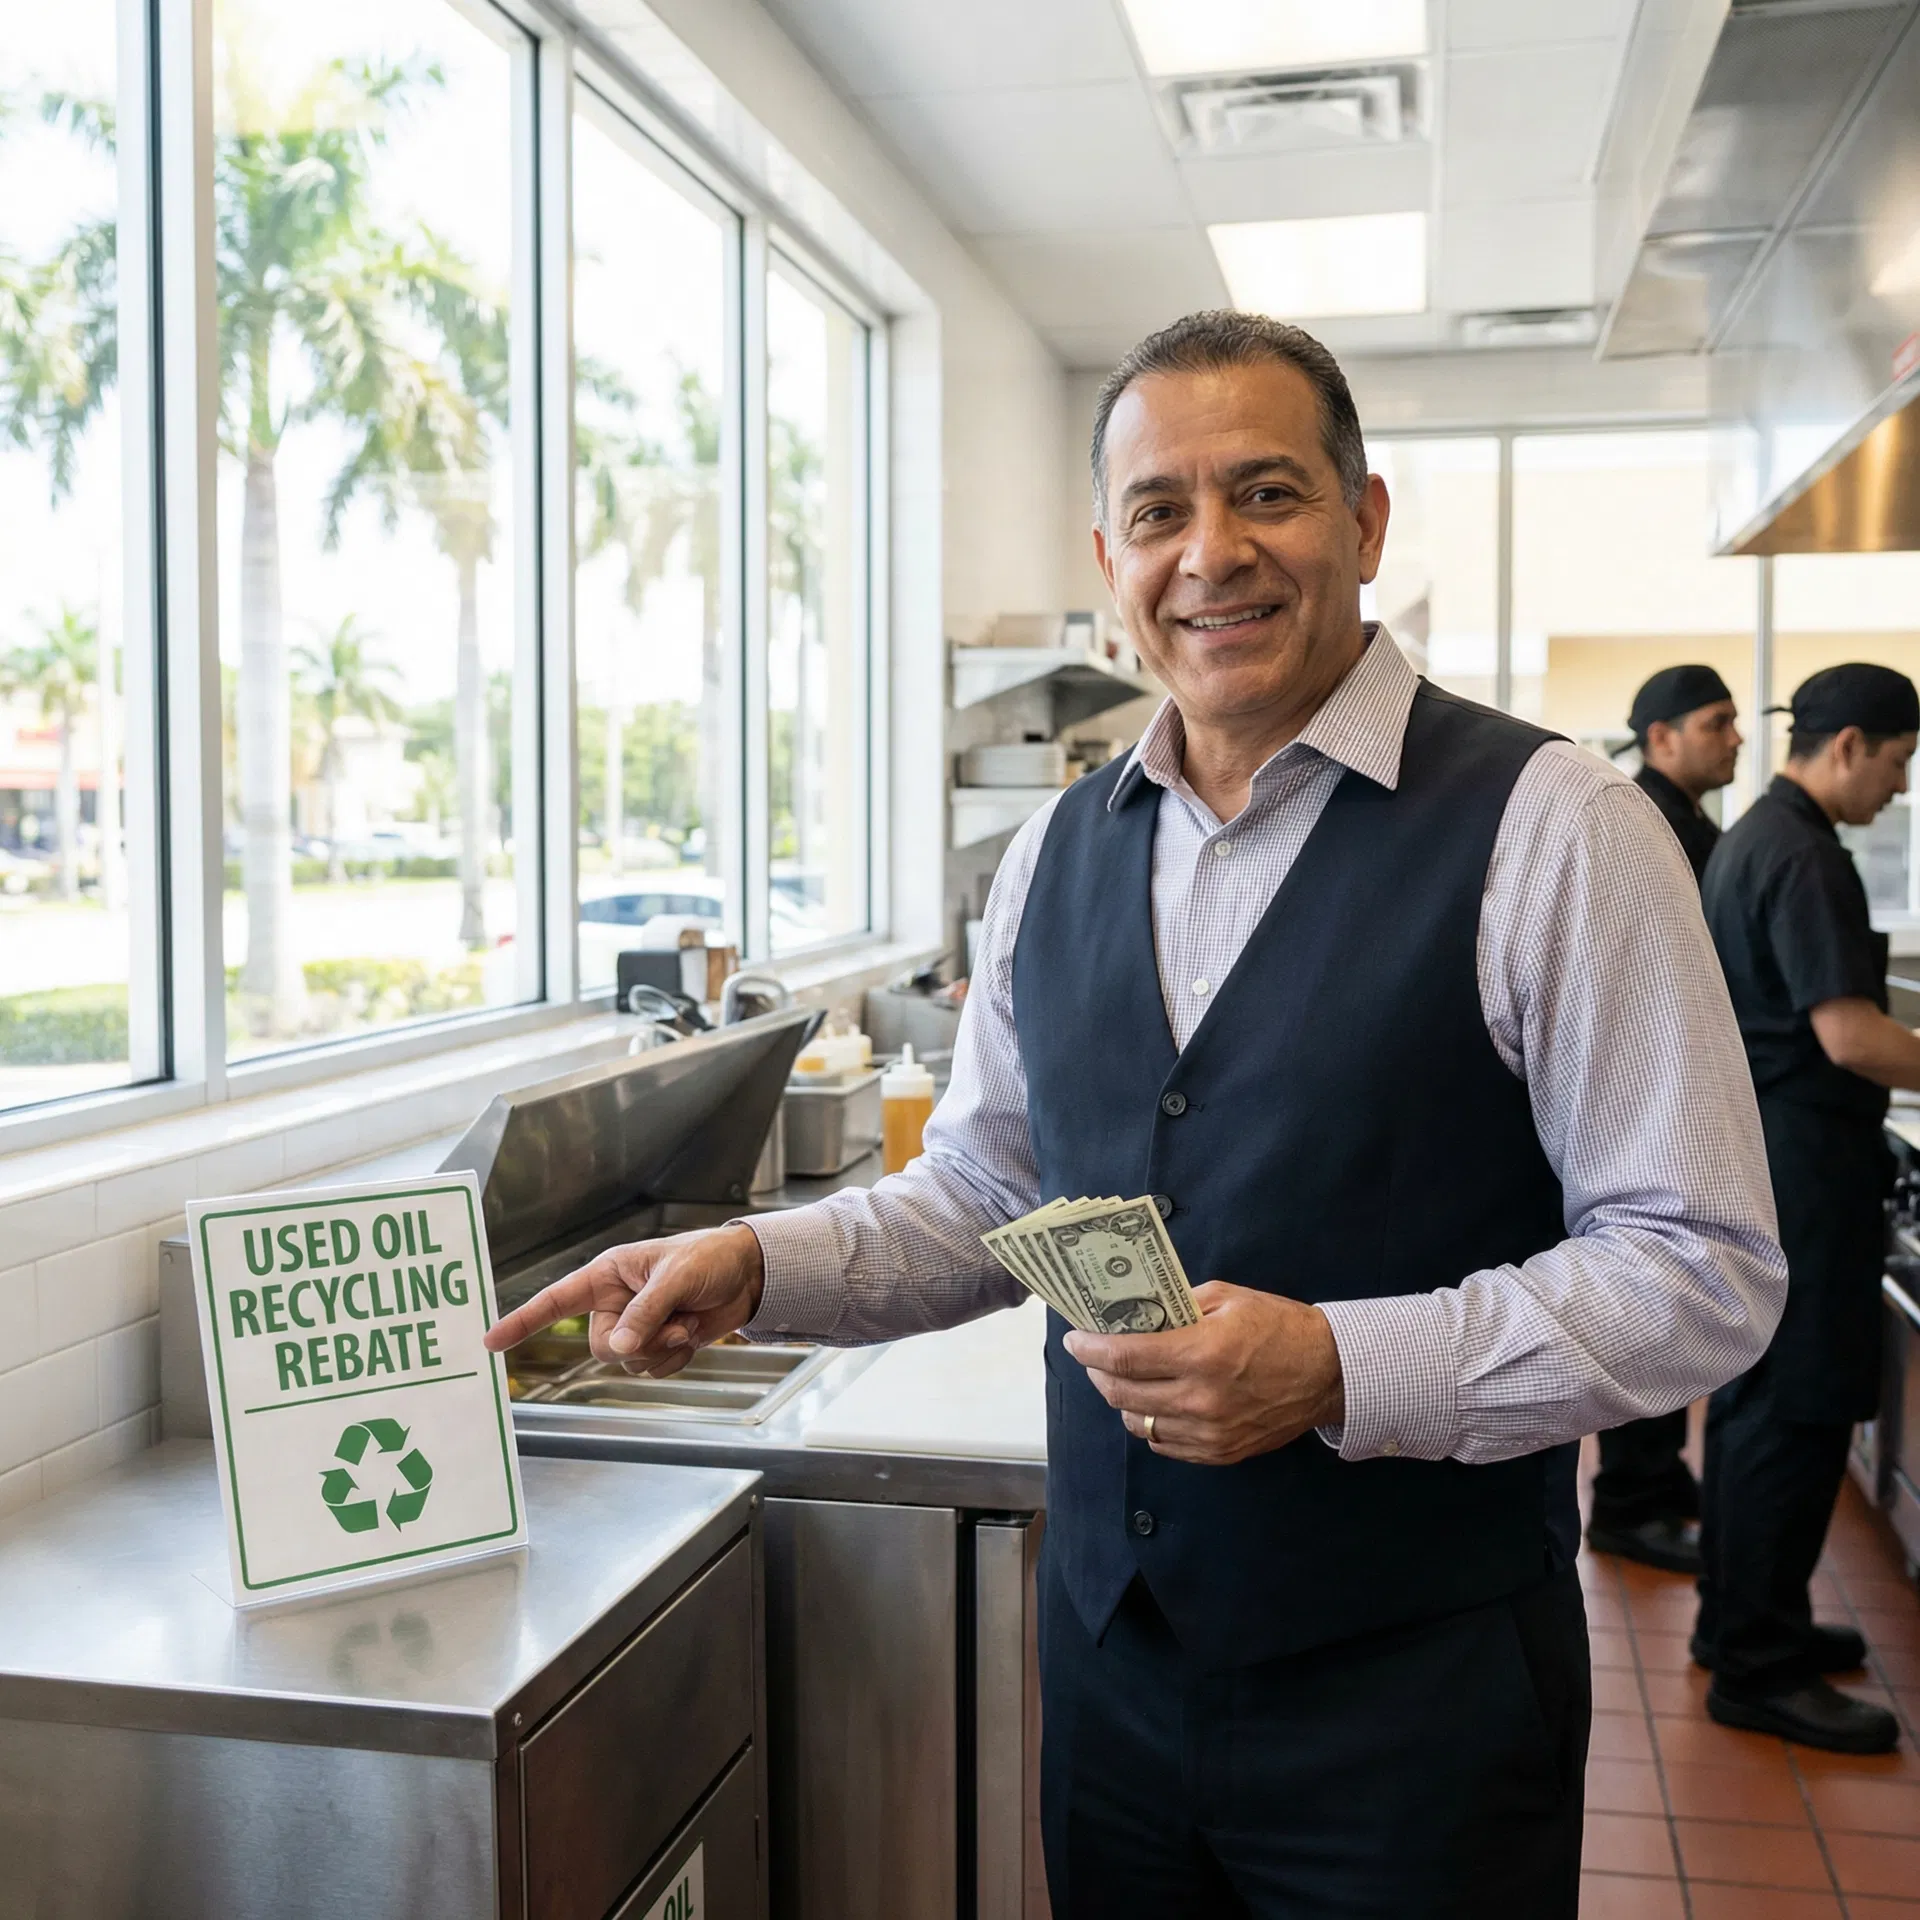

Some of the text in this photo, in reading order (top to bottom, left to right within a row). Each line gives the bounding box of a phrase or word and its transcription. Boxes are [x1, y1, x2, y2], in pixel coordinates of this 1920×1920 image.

[244, 1210, 442, 1276] USED OIL
[229, 1260, 470, 1339] RECYCLING
[275, 1320, 443, 1392] REBATE
